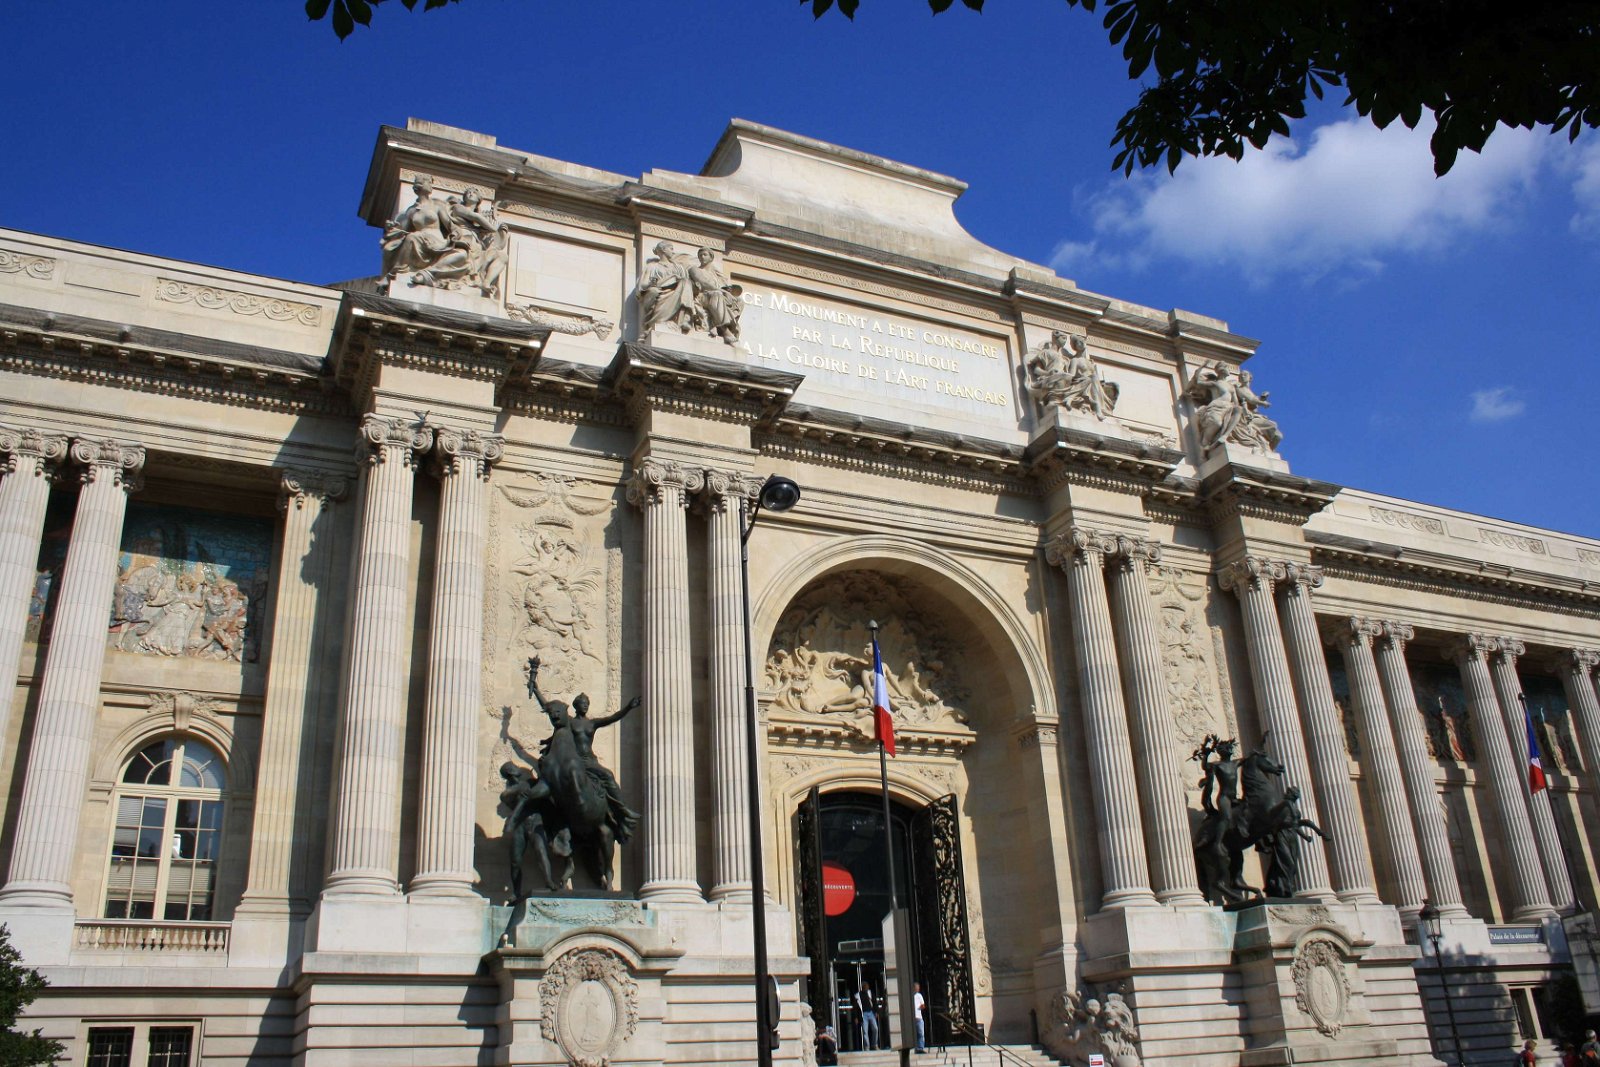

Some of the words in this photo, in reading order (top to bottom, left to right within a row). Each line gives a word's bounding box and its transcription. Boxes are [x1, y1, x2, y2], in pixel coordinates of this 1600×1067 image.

[742, 291, 763, 307] CE
[769, 292, 868, 329] MONUMENT
[872, 320, 884, 334] A
[888, 322, 916, 341] ETE
[923, 331, 999, 359] CONSACRE
[792, 325, 823, 345] PAR
[831, 334, 852, 351] LA
[860, 335, 960, 373] REPUBLIQUE
[743, 341, 754, 355] A
[758, 343, 780, 361] LA
[786, 344, 850, 374] GLOIRE
[858, 363, 878, 381] DE
